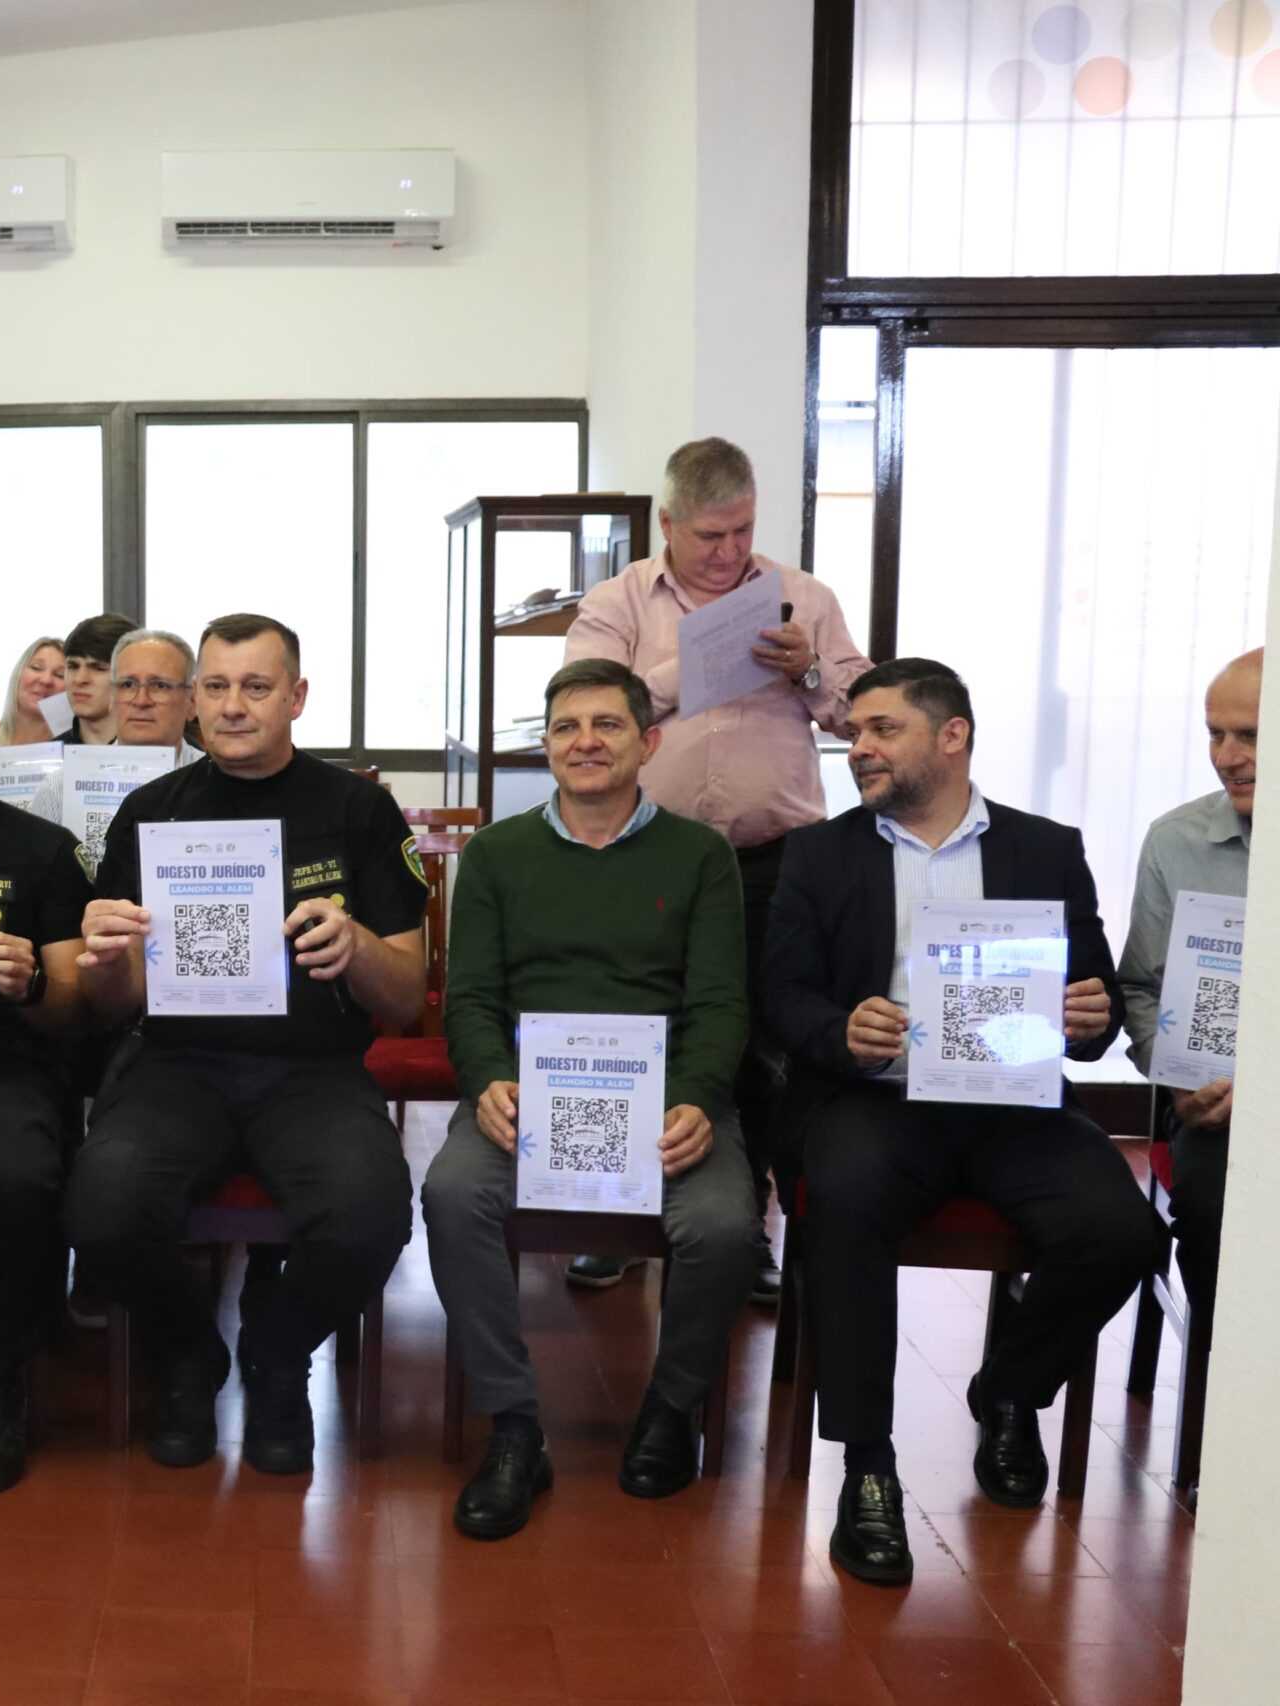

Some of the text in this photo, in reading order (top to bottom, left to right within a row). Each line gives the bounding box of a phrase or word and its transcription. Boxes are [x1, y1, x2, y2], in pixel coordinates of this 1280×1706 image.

[75, 780, 114, 792] DIGESTO
[156, 863, 265, 879] DIGESTO JURÍDICO
[171, 885, 213, 894] LEANDRO
[226, 884, 252, 893] ALEM
[927, 943, 980, 958] DIESO
[1186, 935, 1243, 955] DIGESTO
[536, 1056, 648, 1074] DIGESTO JURÍDICO
[549, 1077, 633, 1088] LEANDRO N. ALEM
